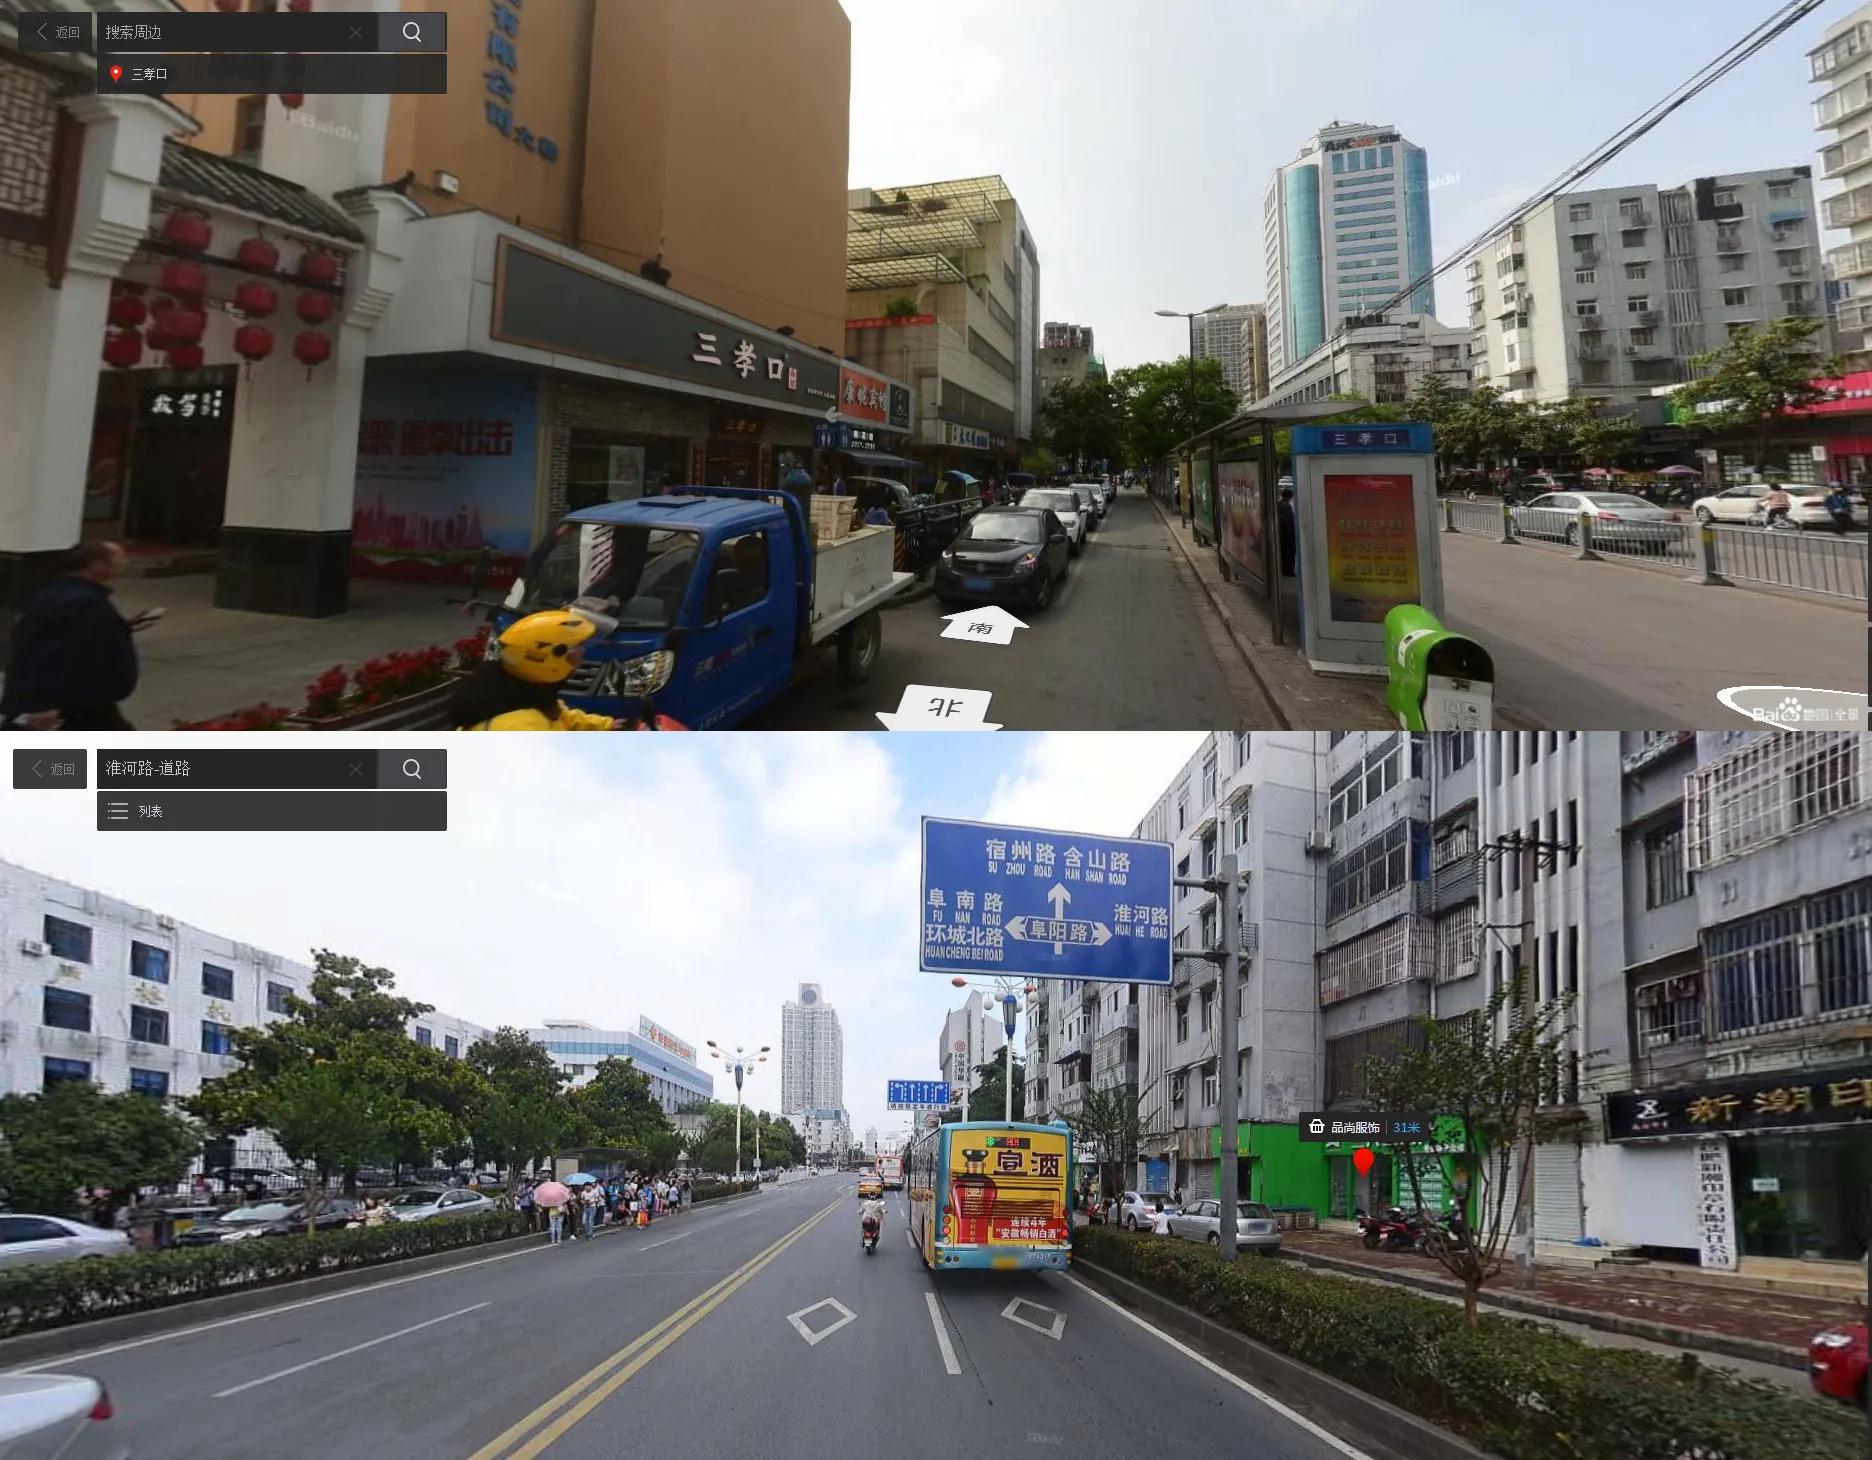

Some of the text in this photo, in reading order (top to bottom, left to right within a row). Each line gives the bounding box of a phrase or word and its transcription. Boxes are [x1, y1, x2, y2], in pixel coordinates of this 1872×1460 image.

[692, 332, 784, 378] 三孝口
[1334, 432, 1398, 445] 三孝口
[986, 839, 1131, 873] 宿州路 含山路
[988, 860, 998, 873] SU
[1006, 862, 1026, 876] ZHOU
[1033, 865, 1053, 878] ROAD
[1085, 870, 1104, 883] SHAN
[1108, 873, 1127, 886] ROAD
[927, 888, 1004, 913] 阜南路
[933, 909, 1001, 926] FU NAN ROAD
[1114, 904, 1169, 926] 淮河路
[926, 924, 1004, 947] 环城北路
[1030, 920, 1088, 943] 阜阳路
[1115, 924, 1168, 940] HUAI HE ROAD
[925, 945, 1004, 962] HUAN CHENG BEI ROAD
[994, 1150, 1064, 1177] 宣酒
[1011, 1216, 1047, 1228] 连续4年
